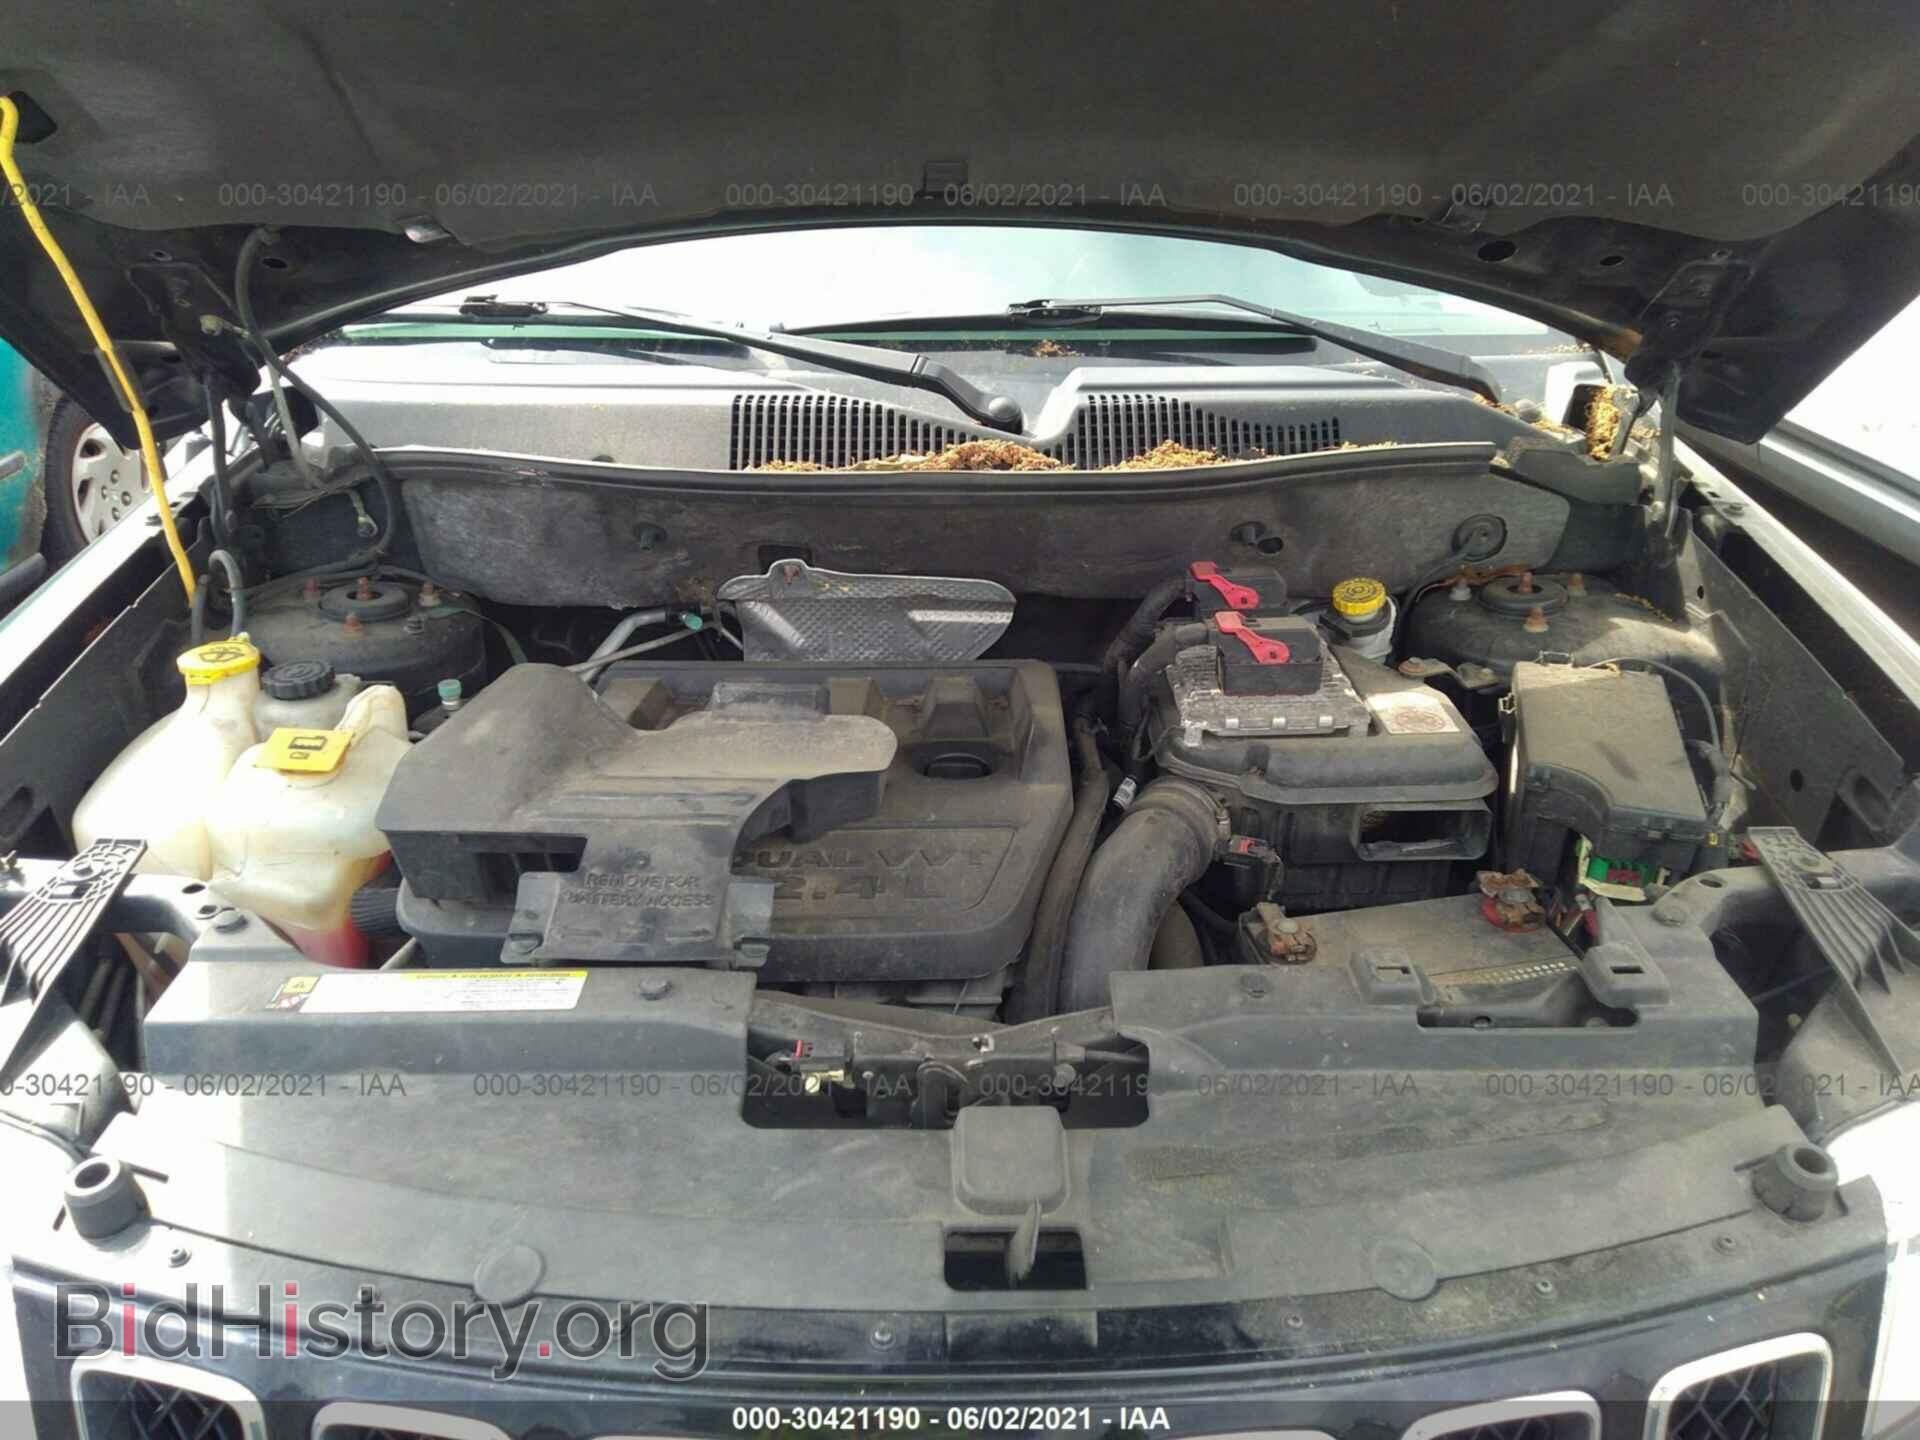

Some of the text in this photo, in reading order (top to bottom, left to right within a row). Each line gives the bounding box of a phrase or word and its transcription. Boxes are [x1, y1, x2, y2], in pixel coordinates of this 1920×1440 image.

[584, 873, 700, 889] REMOVE FOR
[645, 893, 714, 908] ACCESS
